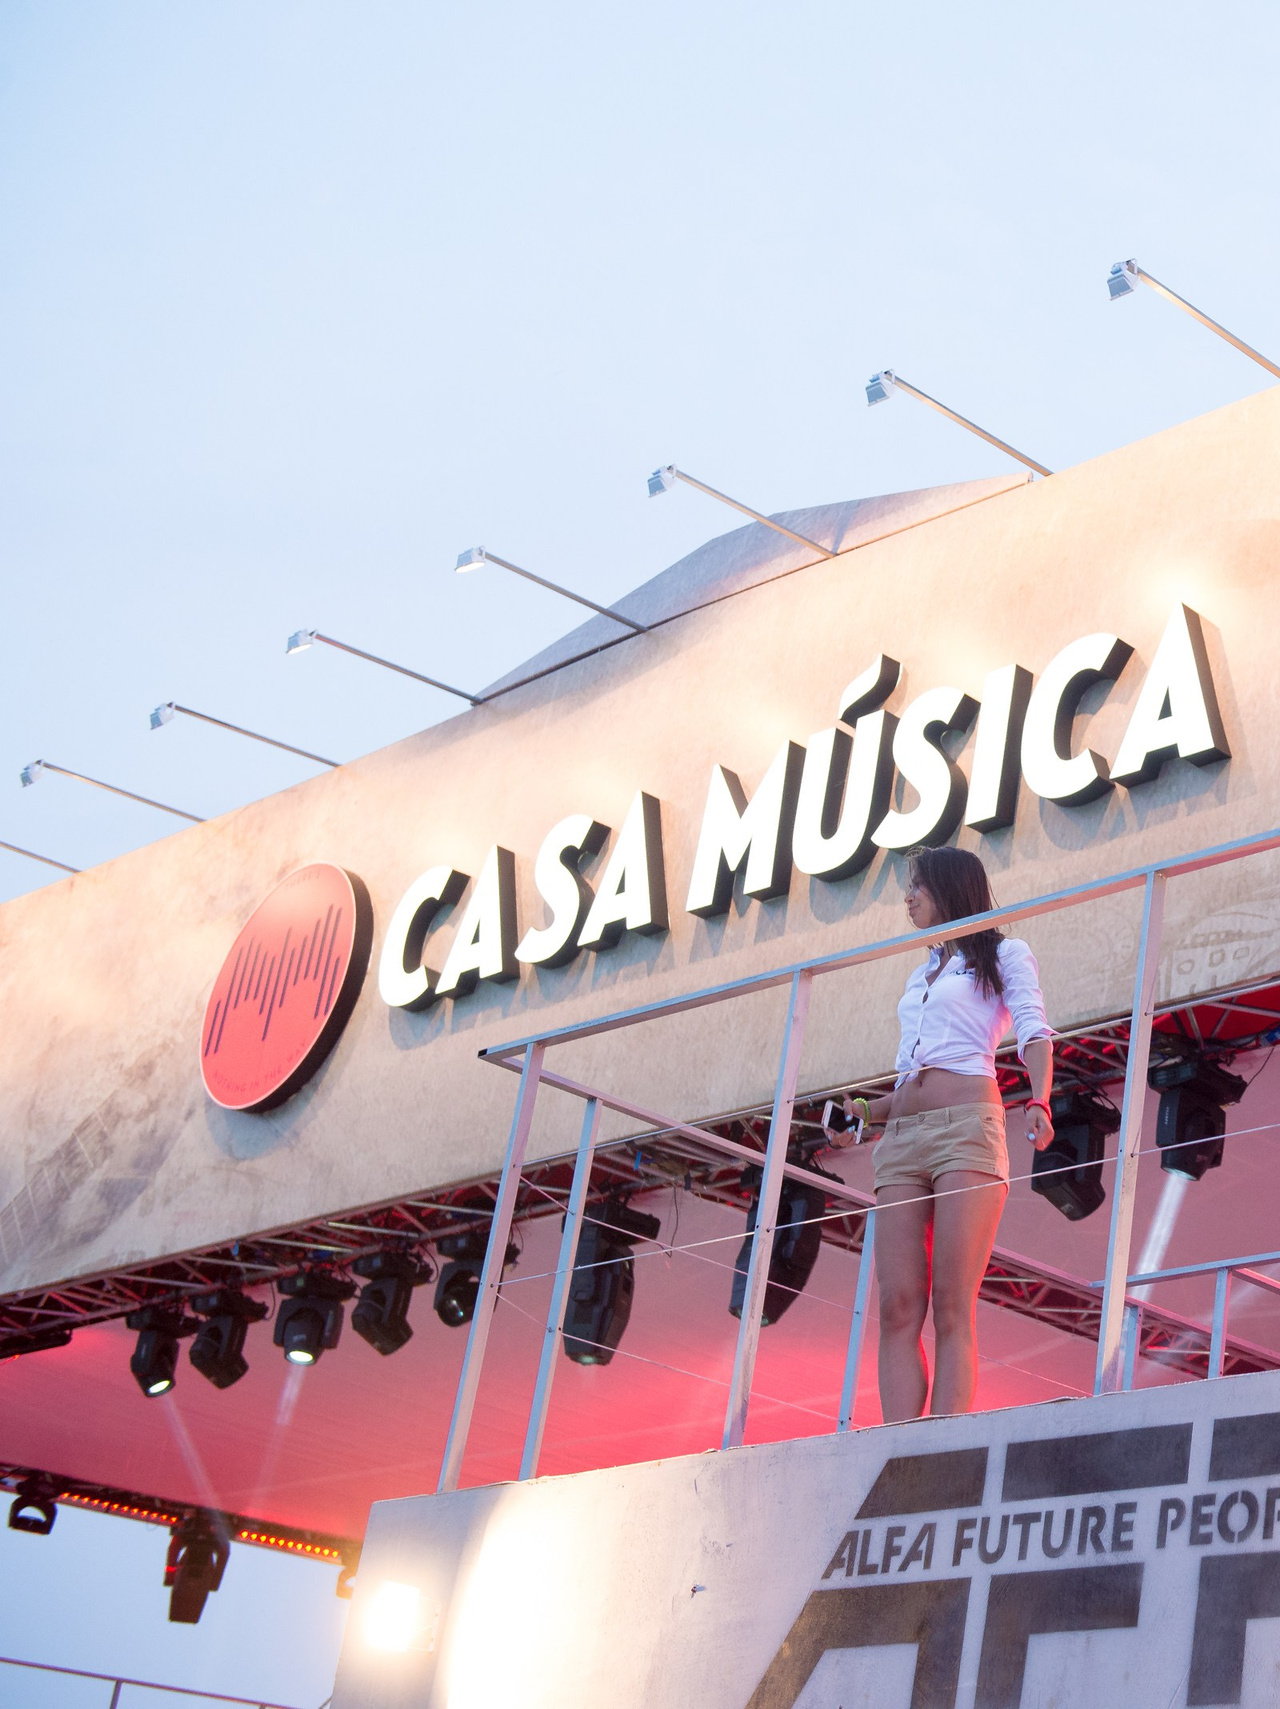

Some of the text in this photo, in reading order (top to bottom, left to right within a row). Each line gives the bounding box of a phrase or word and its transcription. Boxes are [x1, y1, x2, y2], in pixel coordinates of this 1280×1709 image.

[379, 603, 1231, 1012] CASA MÚSICA
[213, 1070, 246, 1092] NOTHING
[250, 1079, 260, 1089] IN
[822, 1523, 934, 1578] ALFA
[952, 1501, 1134, 1566] FUTURE
